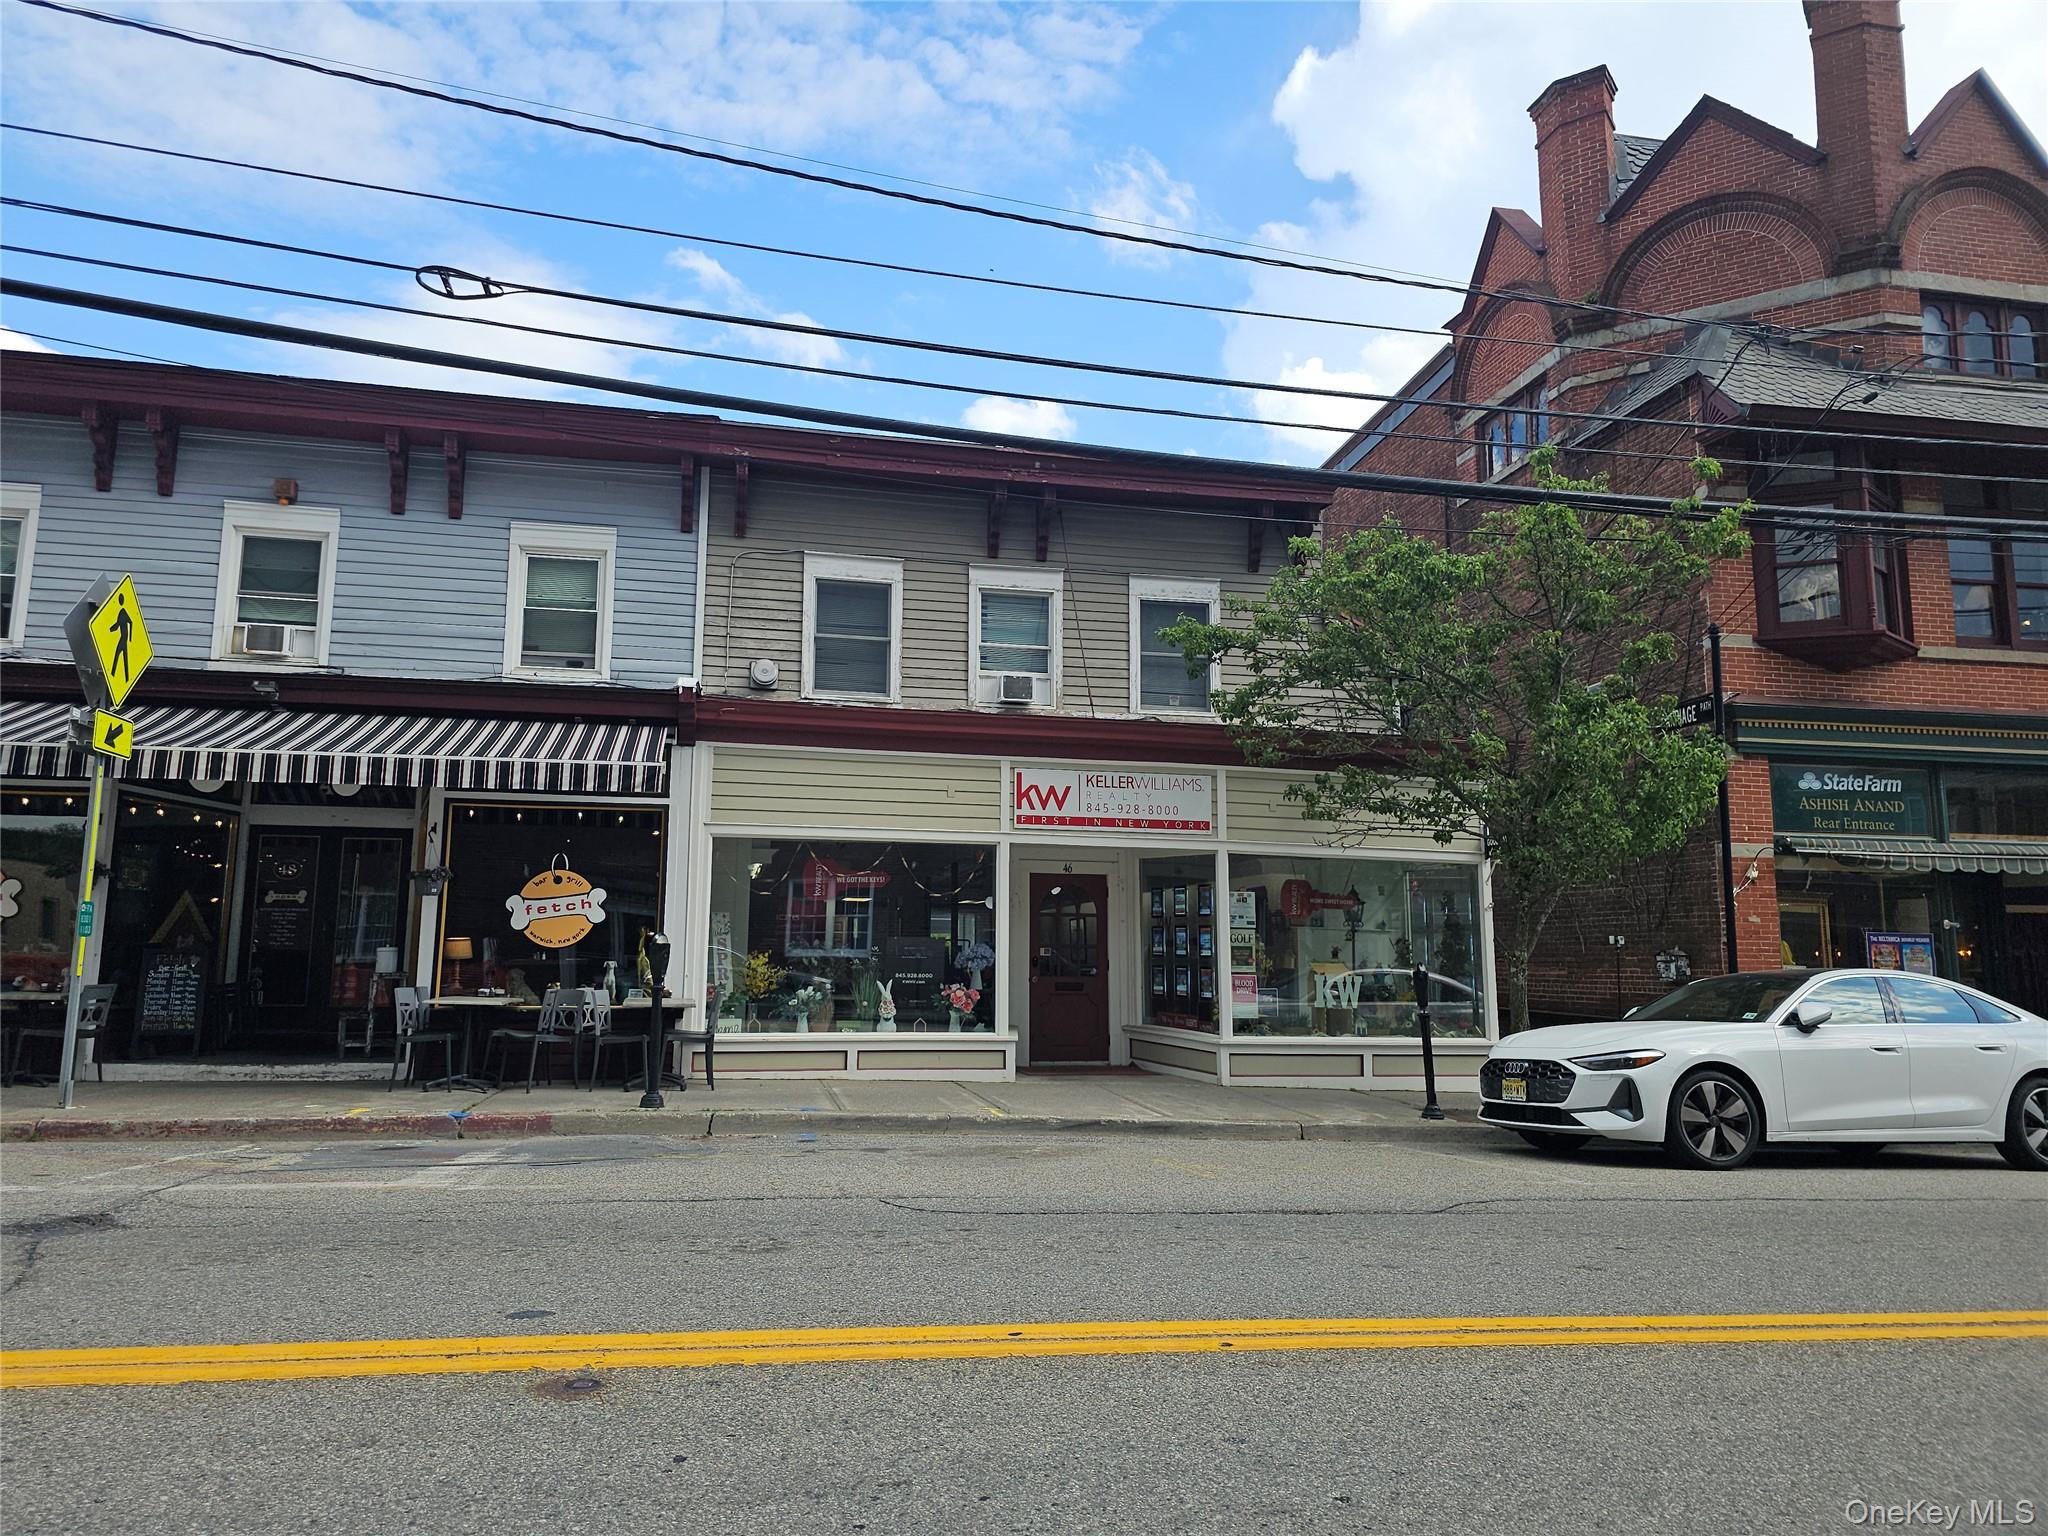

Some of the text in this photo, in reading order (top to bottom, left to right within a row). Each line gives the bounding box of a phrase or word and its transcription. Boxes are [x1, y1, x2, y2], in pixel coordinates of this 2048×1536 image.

[1700, 701, 1712, 712] PATH
[1086, 792, 1152, 800] REALTY
[1086, 803, 1179, 815] 845-928-8000
[1800, 797, 1904, 812] ASHISH ANAND
[1021, 816, 1071, 824] FIRST
[1116, 819, 1148, 828] NEW
[1163, 821, 1207, 830] YORK
[1814, 817, 1895, 830] Rear Entrance
[1062, 863, 1072, 873] 46
[532, 876, 584, 887] bar grill
[524, 899, 592, 915] fetch
[572, 928, 585, 940] york
[1230, 934, 1254, 944] GOLF
[1236, 986, 1252, 994] DRIVE
[1314, 975, 1362, 1008] KW
